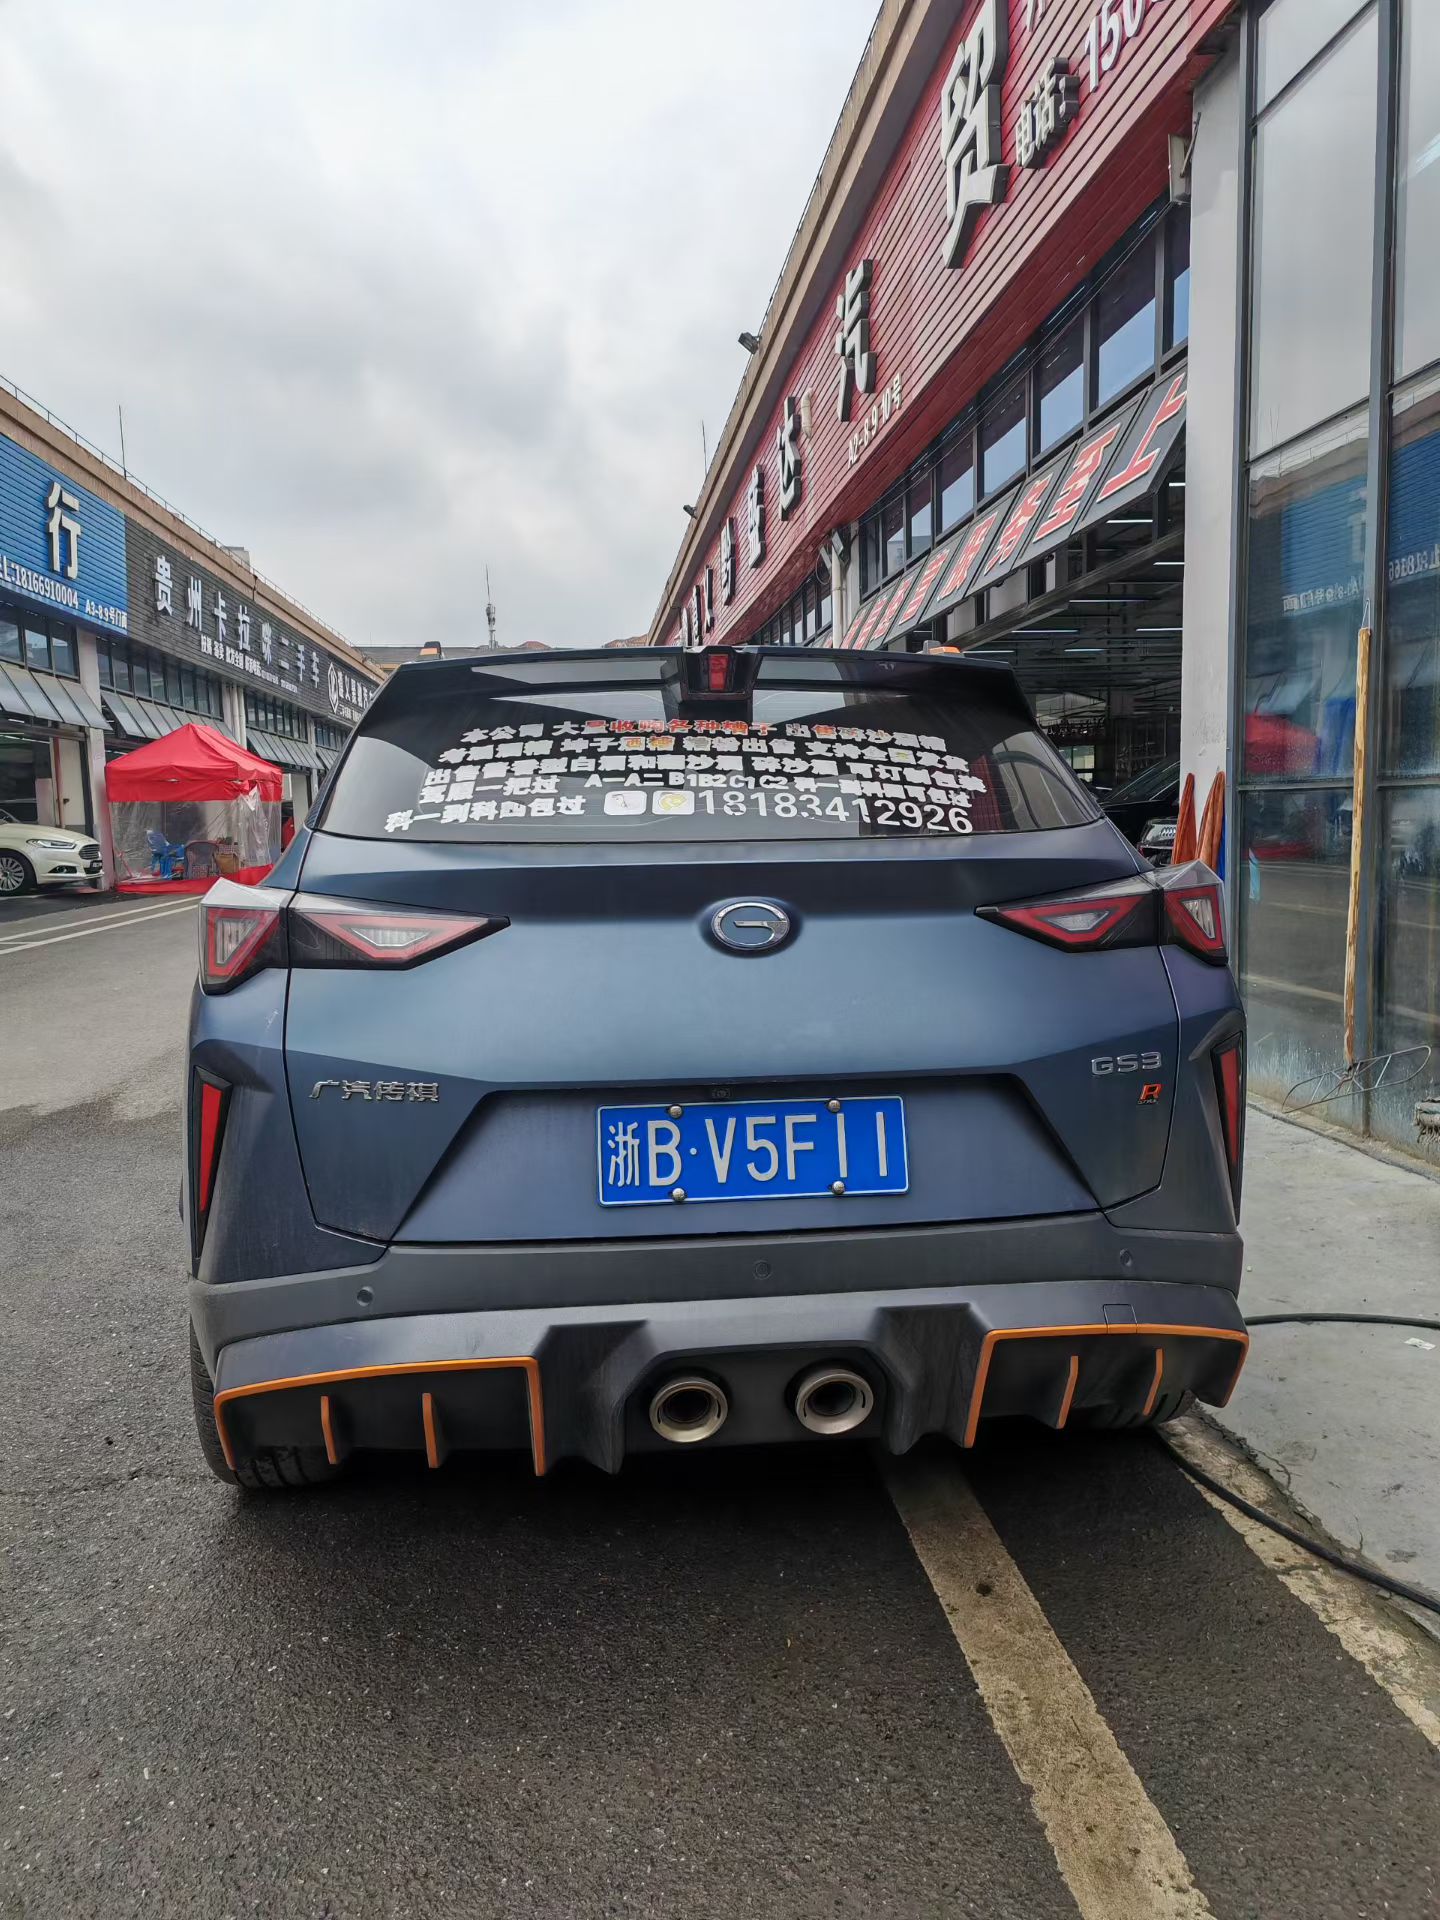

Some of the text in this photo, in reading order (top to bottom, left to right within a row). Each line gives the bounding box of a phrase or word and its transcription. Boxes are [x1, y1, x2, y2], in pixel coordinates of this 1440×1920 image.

[1084, 0, 1160, 93] 150
[46, 481, 82, 580] 行
[698, 790, 973, 834] 18183412926
[1091, 1052, 1162, 1075] GS3
[308, 1079, 440, 1102] 广汽传祺
